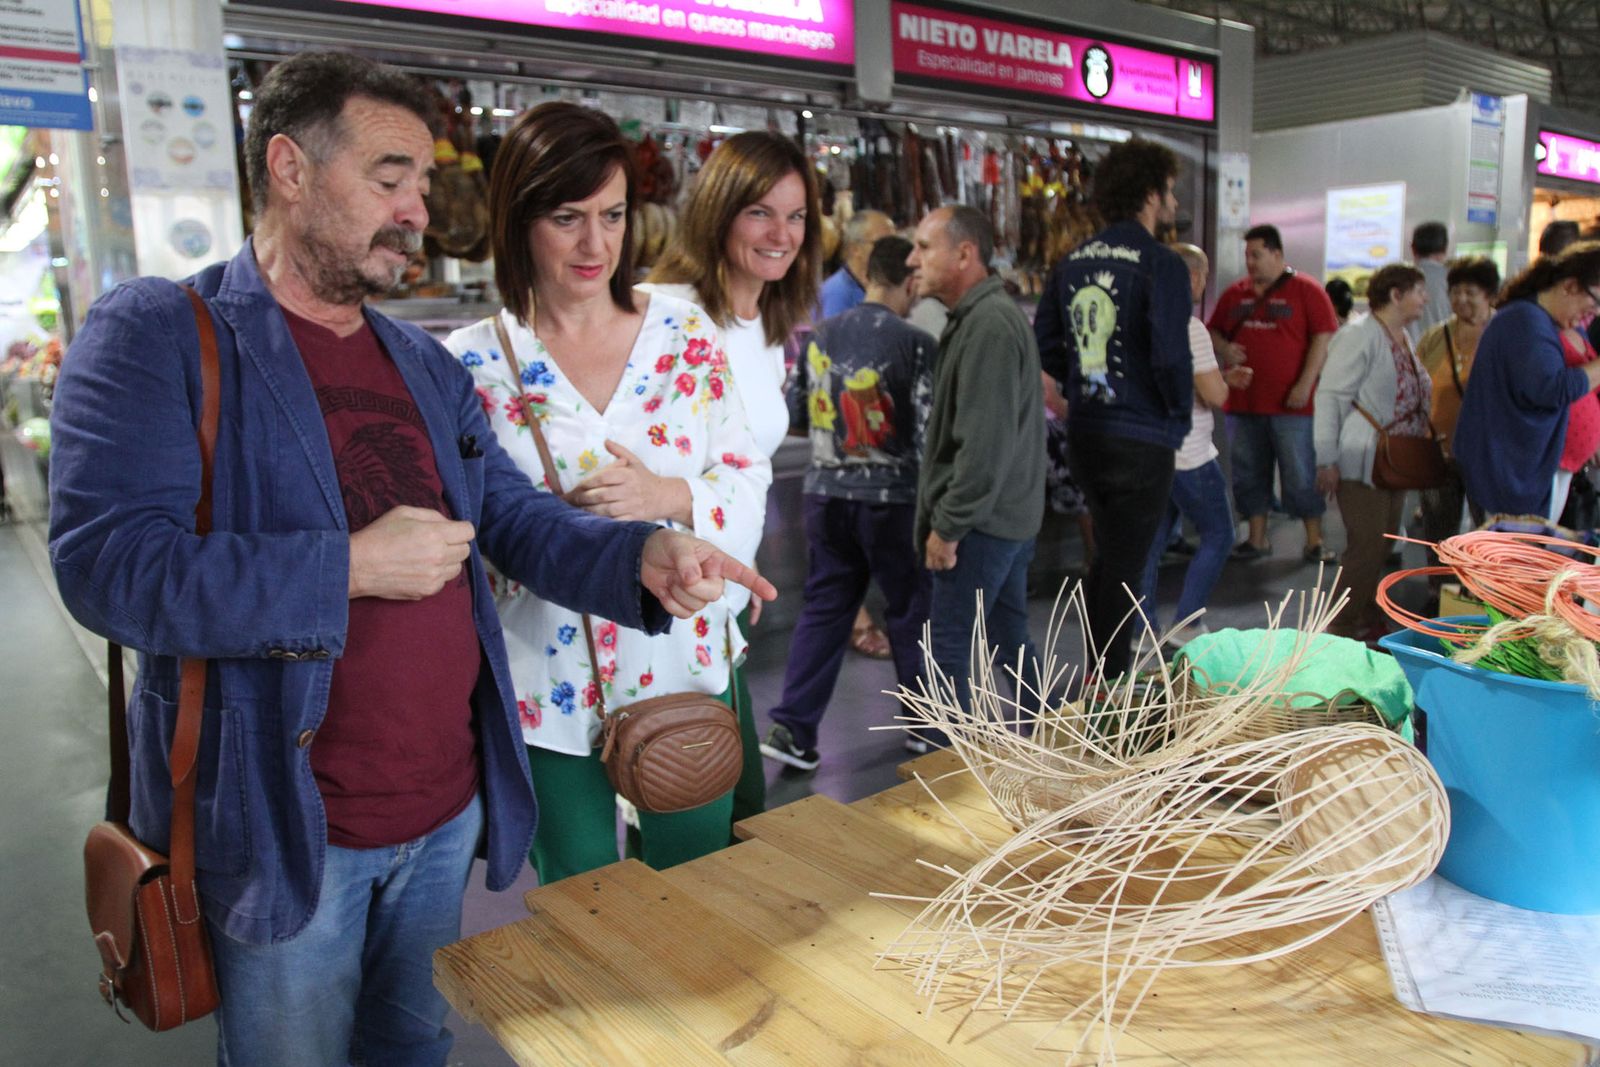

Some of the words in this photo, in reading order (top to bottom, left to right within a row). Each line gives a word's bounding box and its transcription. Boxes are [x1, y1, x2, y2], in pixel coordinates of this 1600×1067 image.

[662, 8, 686, 28] en
[688, 12, 746, 37] quesos
[747, 21, 835, 50] manchegos
[899, 13, 977, 50] NIETO
[983, 28, 1073, 68] VARELA
[918, 50, 996, 76] Especialidad
[998, 63, 1014, 79] en
[1016, 66, 1064, 89] jamones
